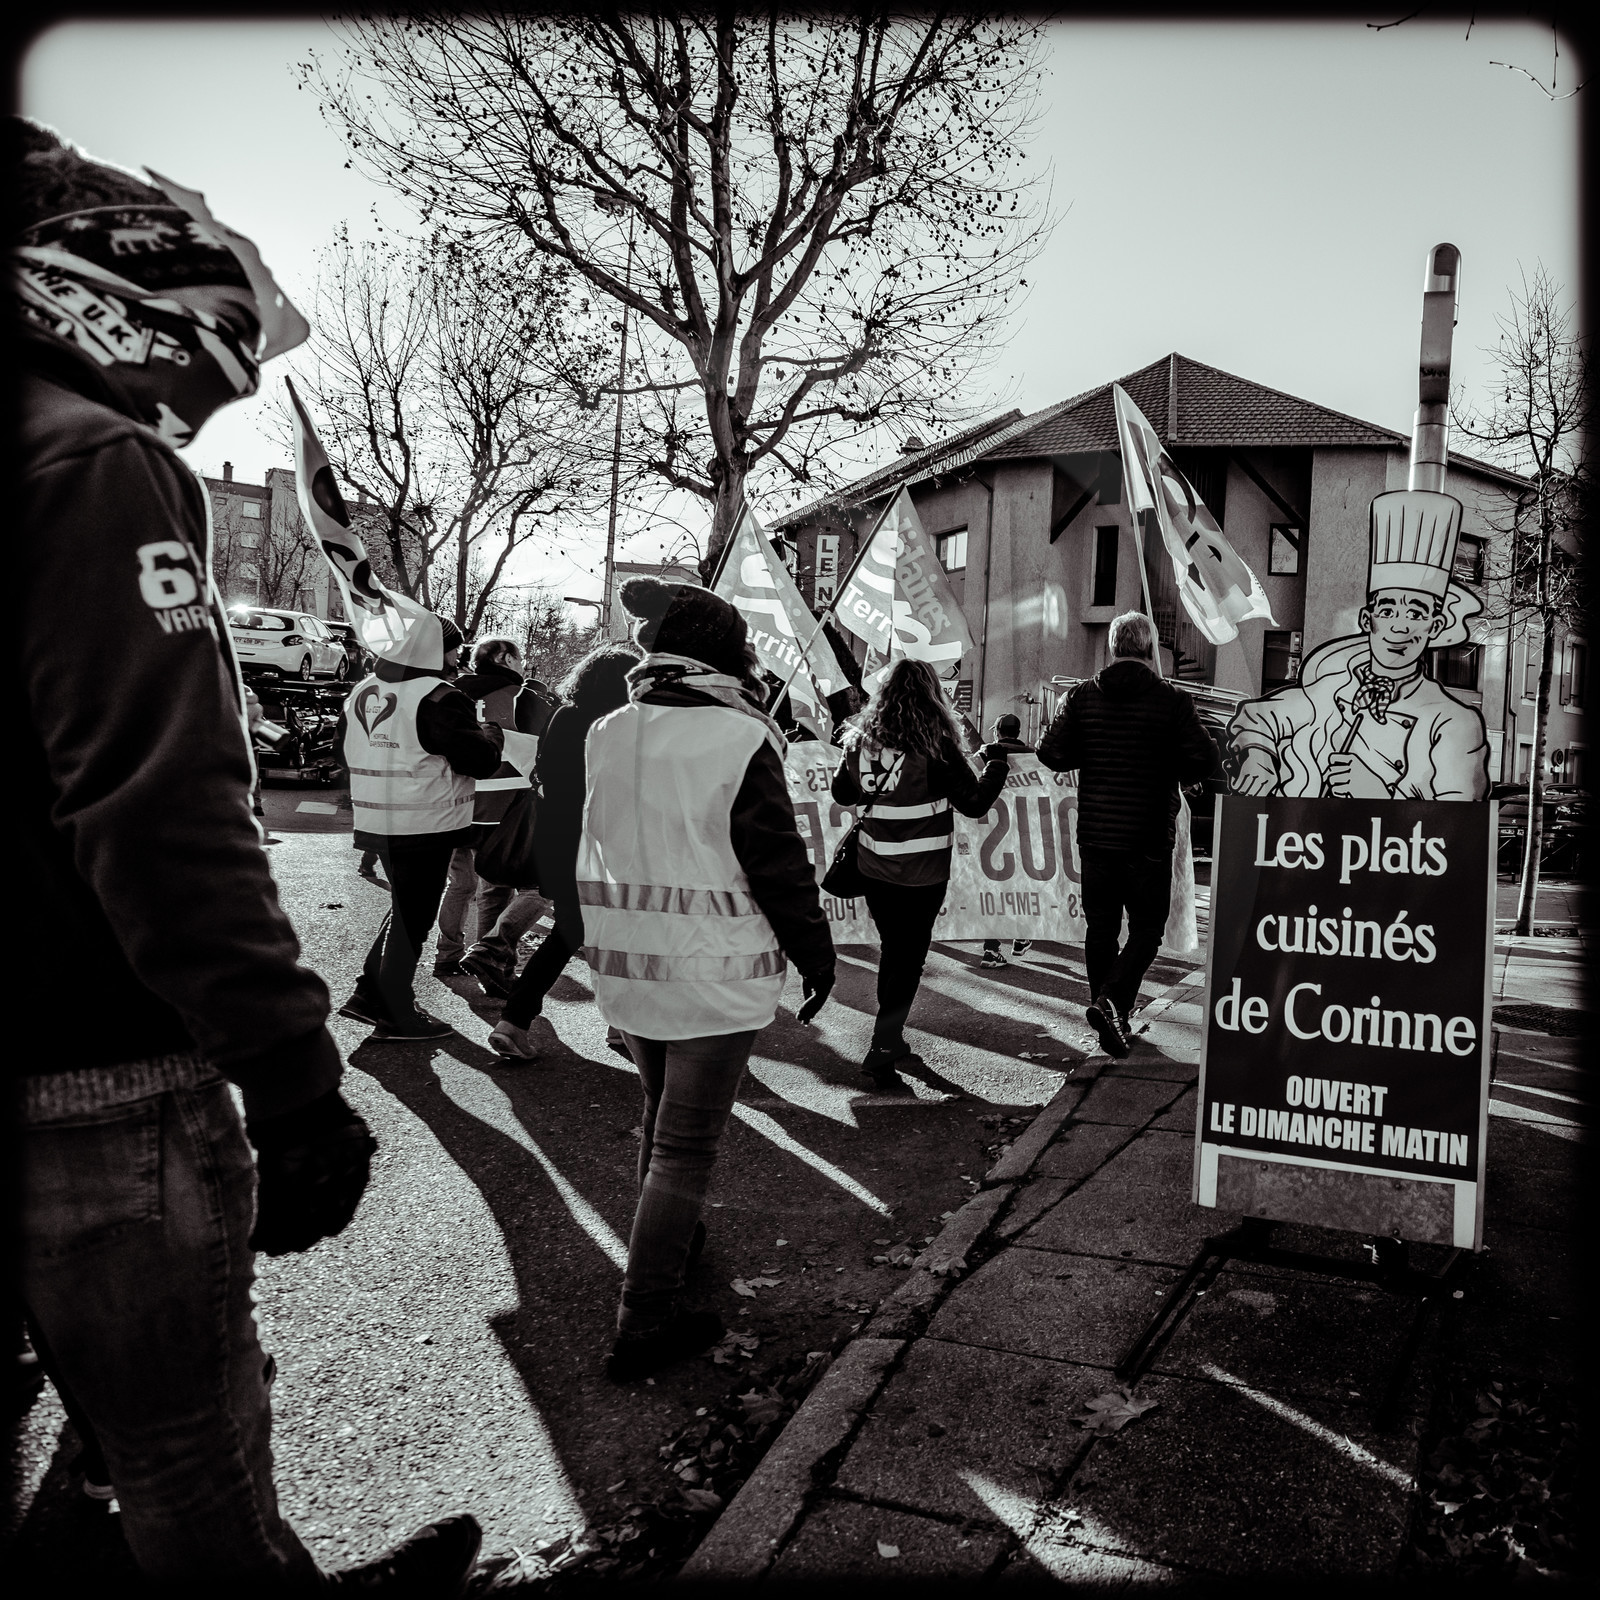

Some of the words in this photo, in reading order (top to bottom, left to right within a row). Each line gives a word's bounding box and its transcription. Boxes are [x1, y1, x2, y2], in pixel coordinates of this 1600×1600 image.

[1254, 813, 1325, 870] Les
[1339, 817, 1448, 884] plats
[1256, 904, 1437, 963] cuisinés
[1215, 977, 1269, 1034] de
[1284, 982, 1476, 1056] Corinne
[1286, 1075, 1388, 1117] OUVERT
[1210, 1102, 1235, 1134] LE
[1240, 1106, 1375, 1154] DIMANCHE
[1381, 1124, 1468, 1166] MATIN
